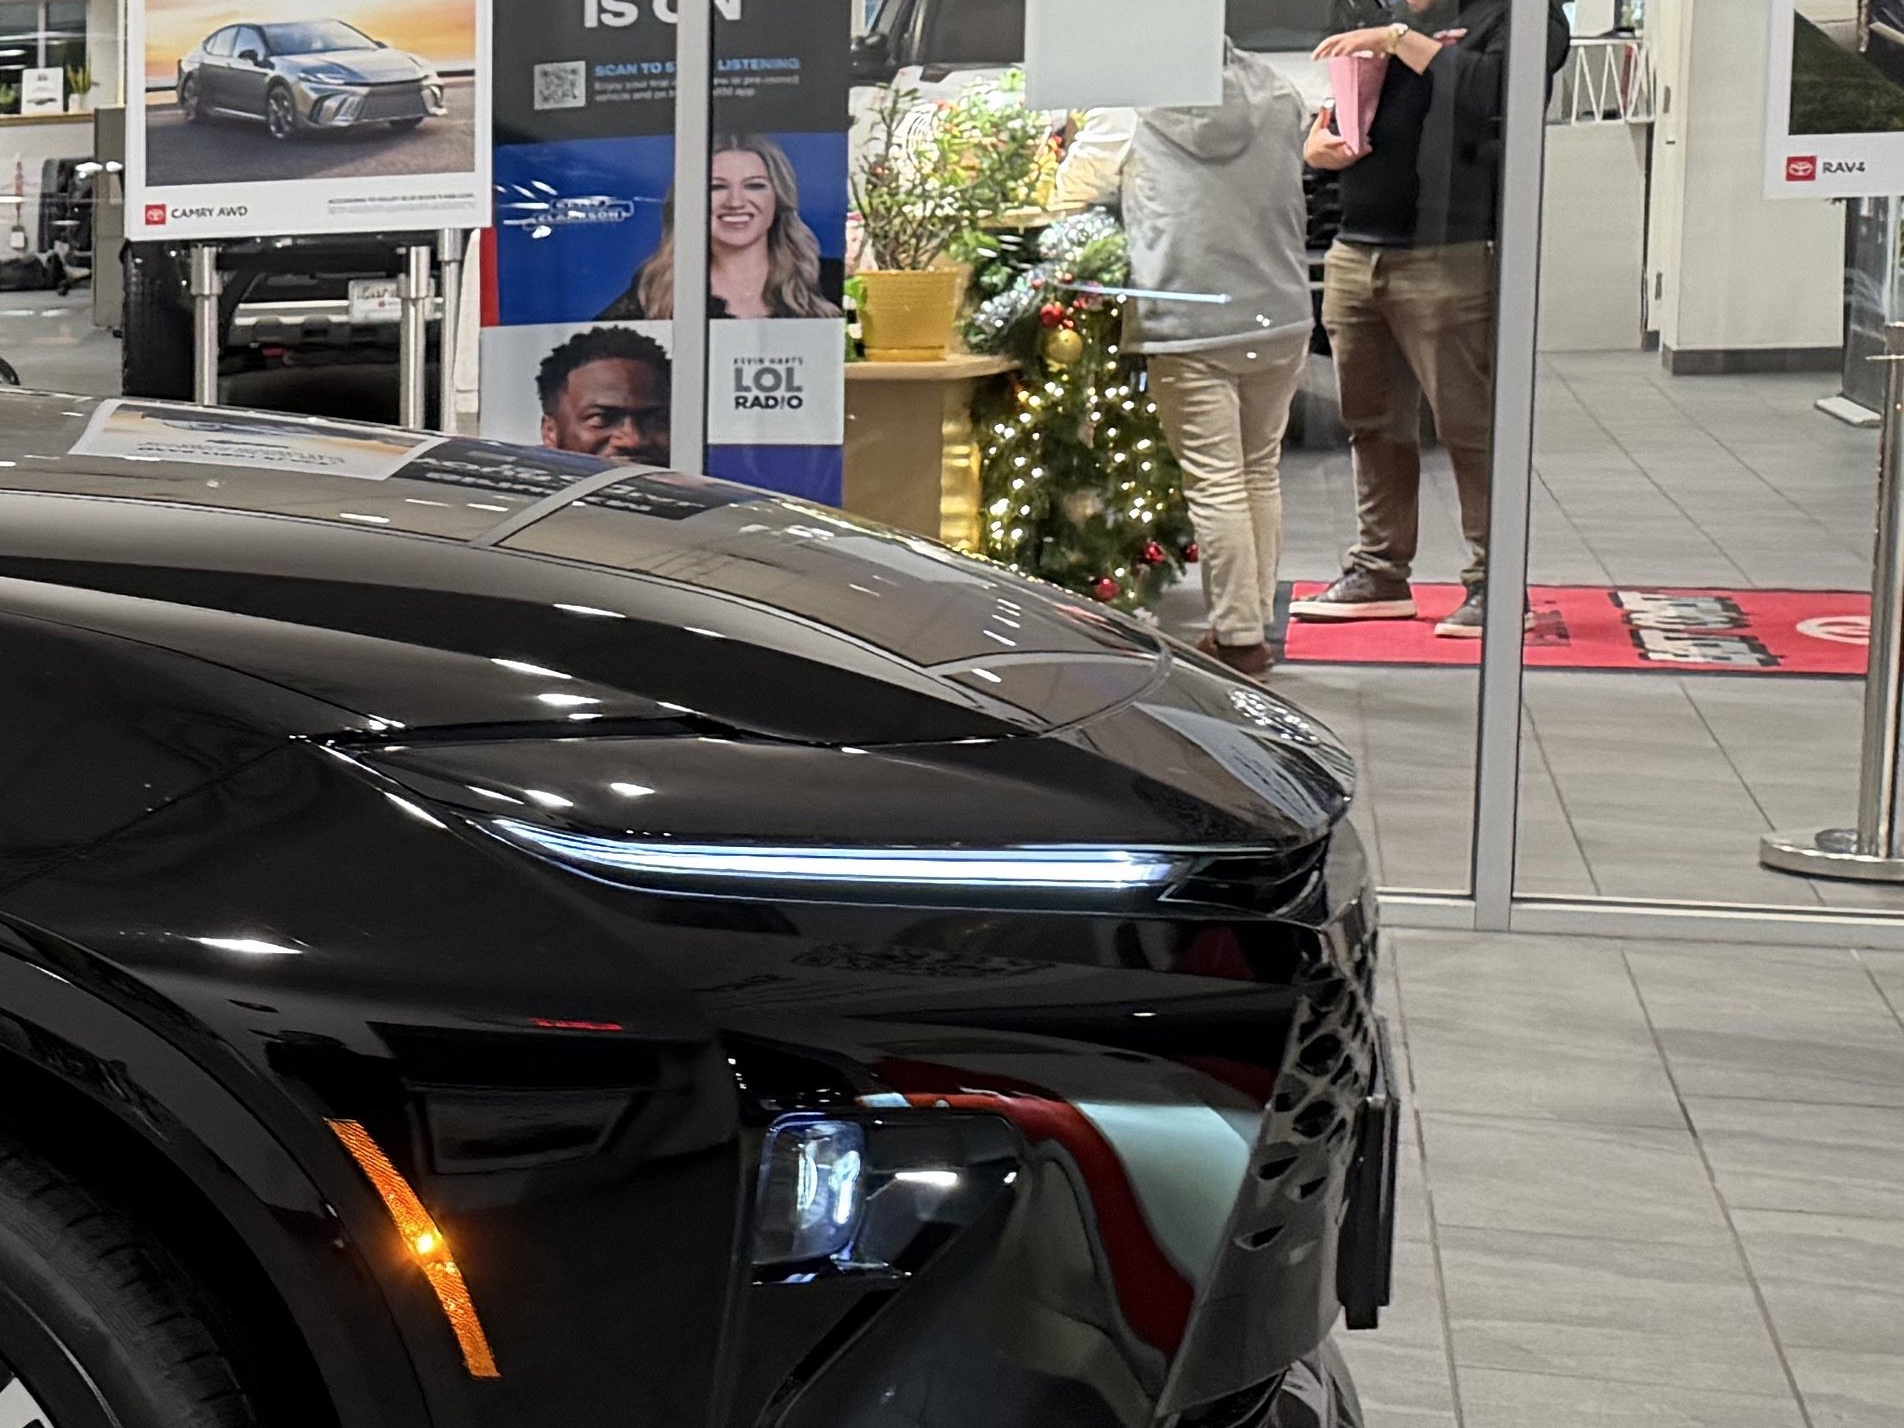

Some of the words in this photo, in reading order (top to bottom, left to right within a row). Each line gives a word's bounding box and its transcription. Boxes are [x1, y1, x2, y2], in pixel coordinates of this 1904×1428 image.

[595, 63, 638, 77] SCAN
[641, 62, 662, 74] TO
[170, 207, 214, 219] CAMRY
[216, 205, 248, 218] AWD
[734, 366, 803, 393] LOL
